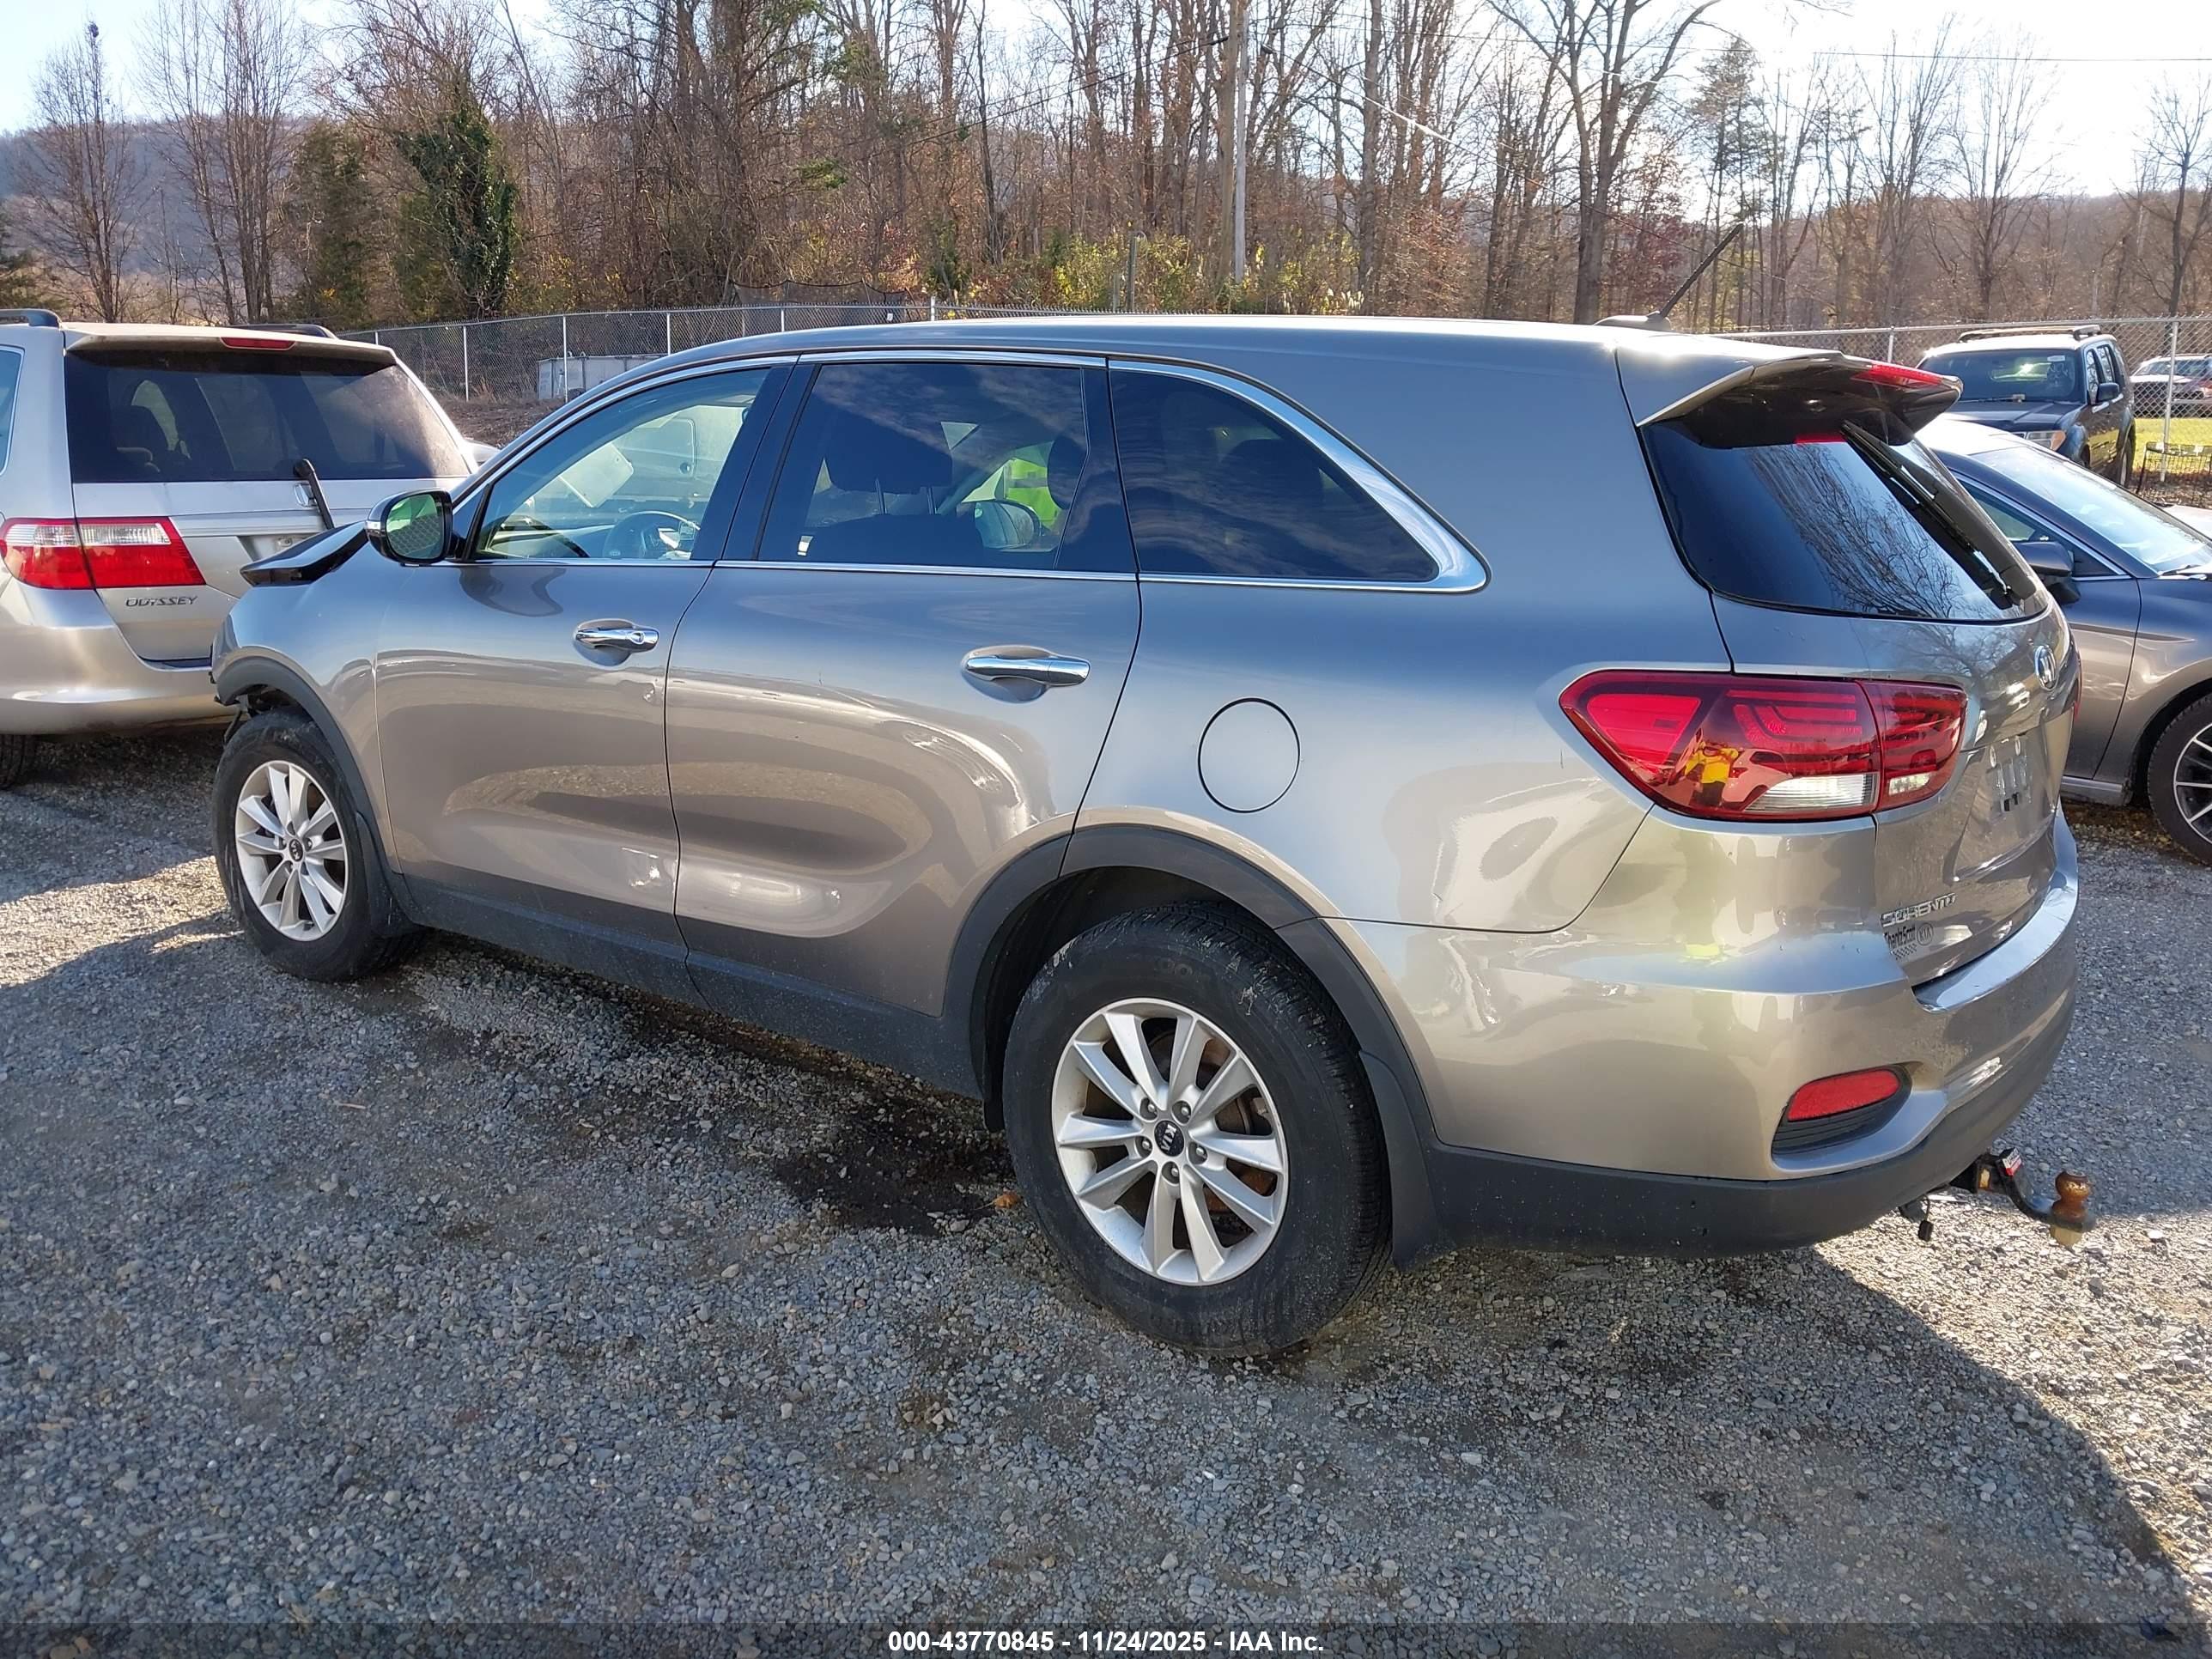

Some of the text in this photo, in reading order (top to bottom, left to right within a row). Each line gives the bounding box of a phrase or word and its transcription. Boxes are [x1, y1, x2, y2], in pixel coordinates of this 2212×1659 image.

[125, 596, 198, 607] ODYSSEY
[1881, 892, 1957, 927] SORENTO
[1160, 1123, 1177, 1152] KIA
